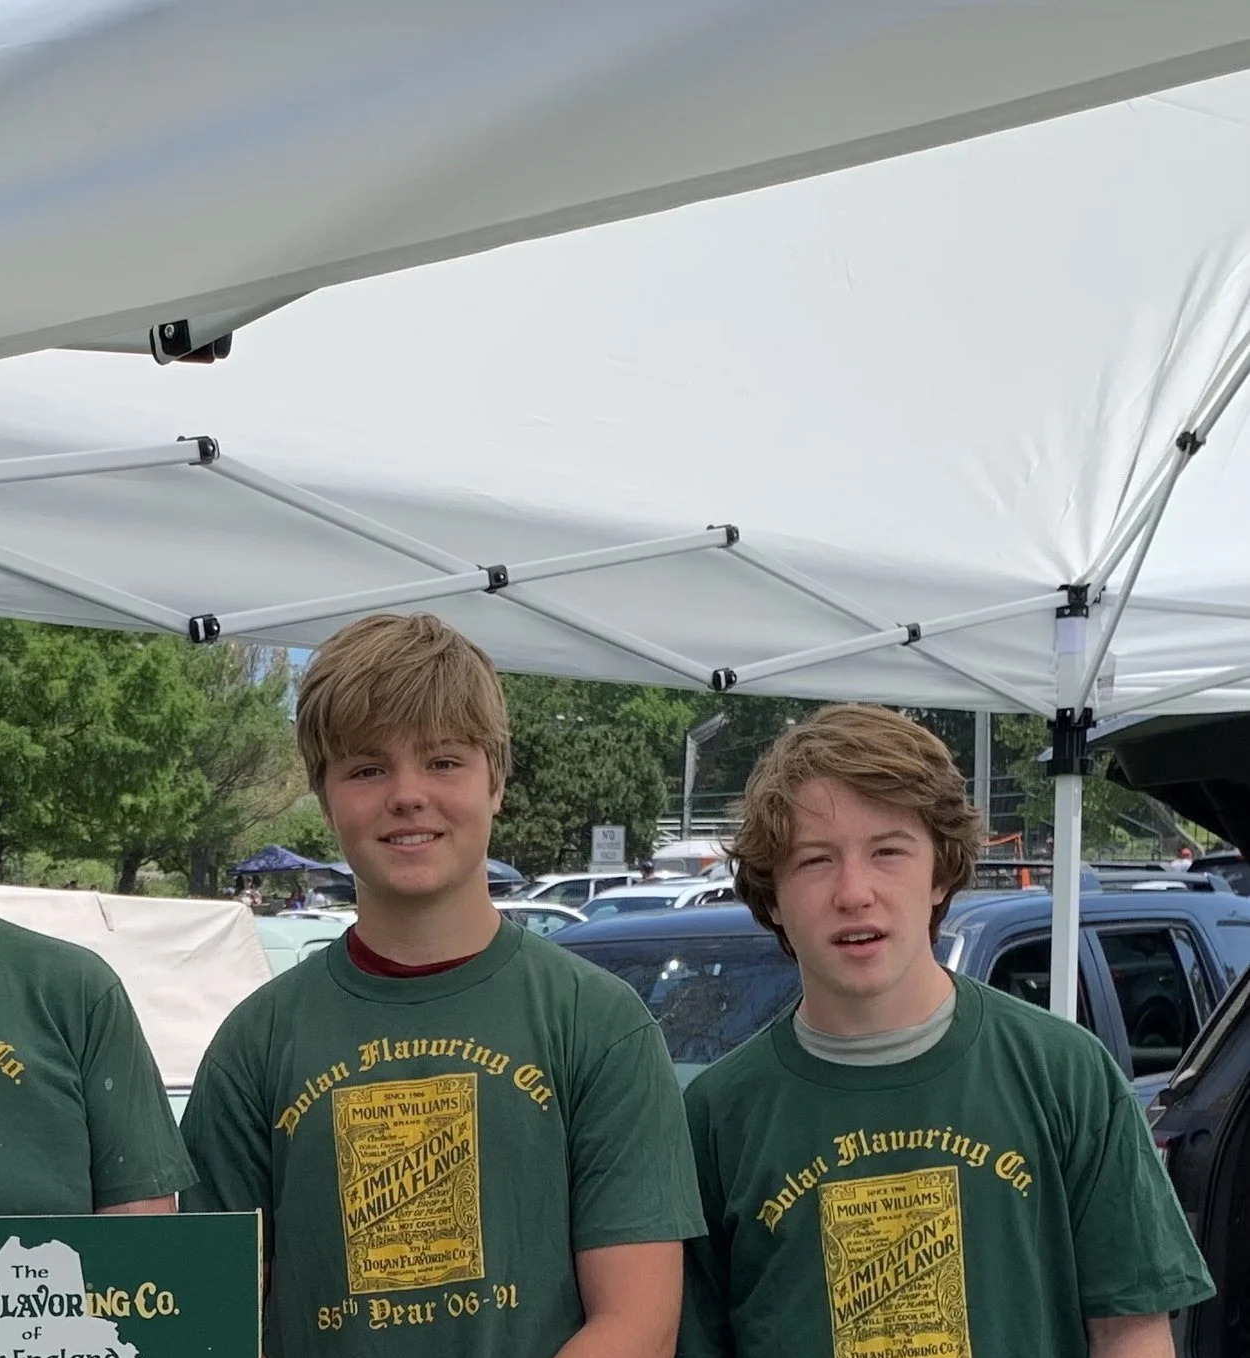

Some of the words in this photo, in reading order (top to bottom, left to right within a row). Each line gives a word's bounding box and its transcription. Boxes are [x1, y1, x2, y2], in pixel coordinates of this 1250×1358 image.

[275, 1061, 350, 1141] Dolan
[357, 1037, 510, 1075] Flavoring
[513, 1064, 554, 1111] Co.
[351, 1104, 395, 1120] MOUNT
[398, 1097, 458, 1116] WILLIAMS
[348, 1182, 409, 1231] VANILLA
[412, 1139, 472, 1195] FLAVOR
[364, 1125, 454, 1199] IMITATION
[756, 1156, 829, 1235] Dolan
[833, 1126, 991, 1168] Flavoring
[995, 1150, 1033, 1197] Co.
[837, 1201, 878, 1218] MOUNT
[880, 1192, 941, 1210] WILLIAMS
[11, 1264, 49, 1279] The
[363, 1257, 399, 1273] DOLAN
[837, 1276, 891, 1324] VANILLA
[894, 1234, 955, 1287] FLAVOR
[850, 1220, 936, 1292] IMITATION
[22, 1326, 43, 1341] of
[317, 1297, 359, 1330] 85th
[368, 1297, 436, 1329] Year
